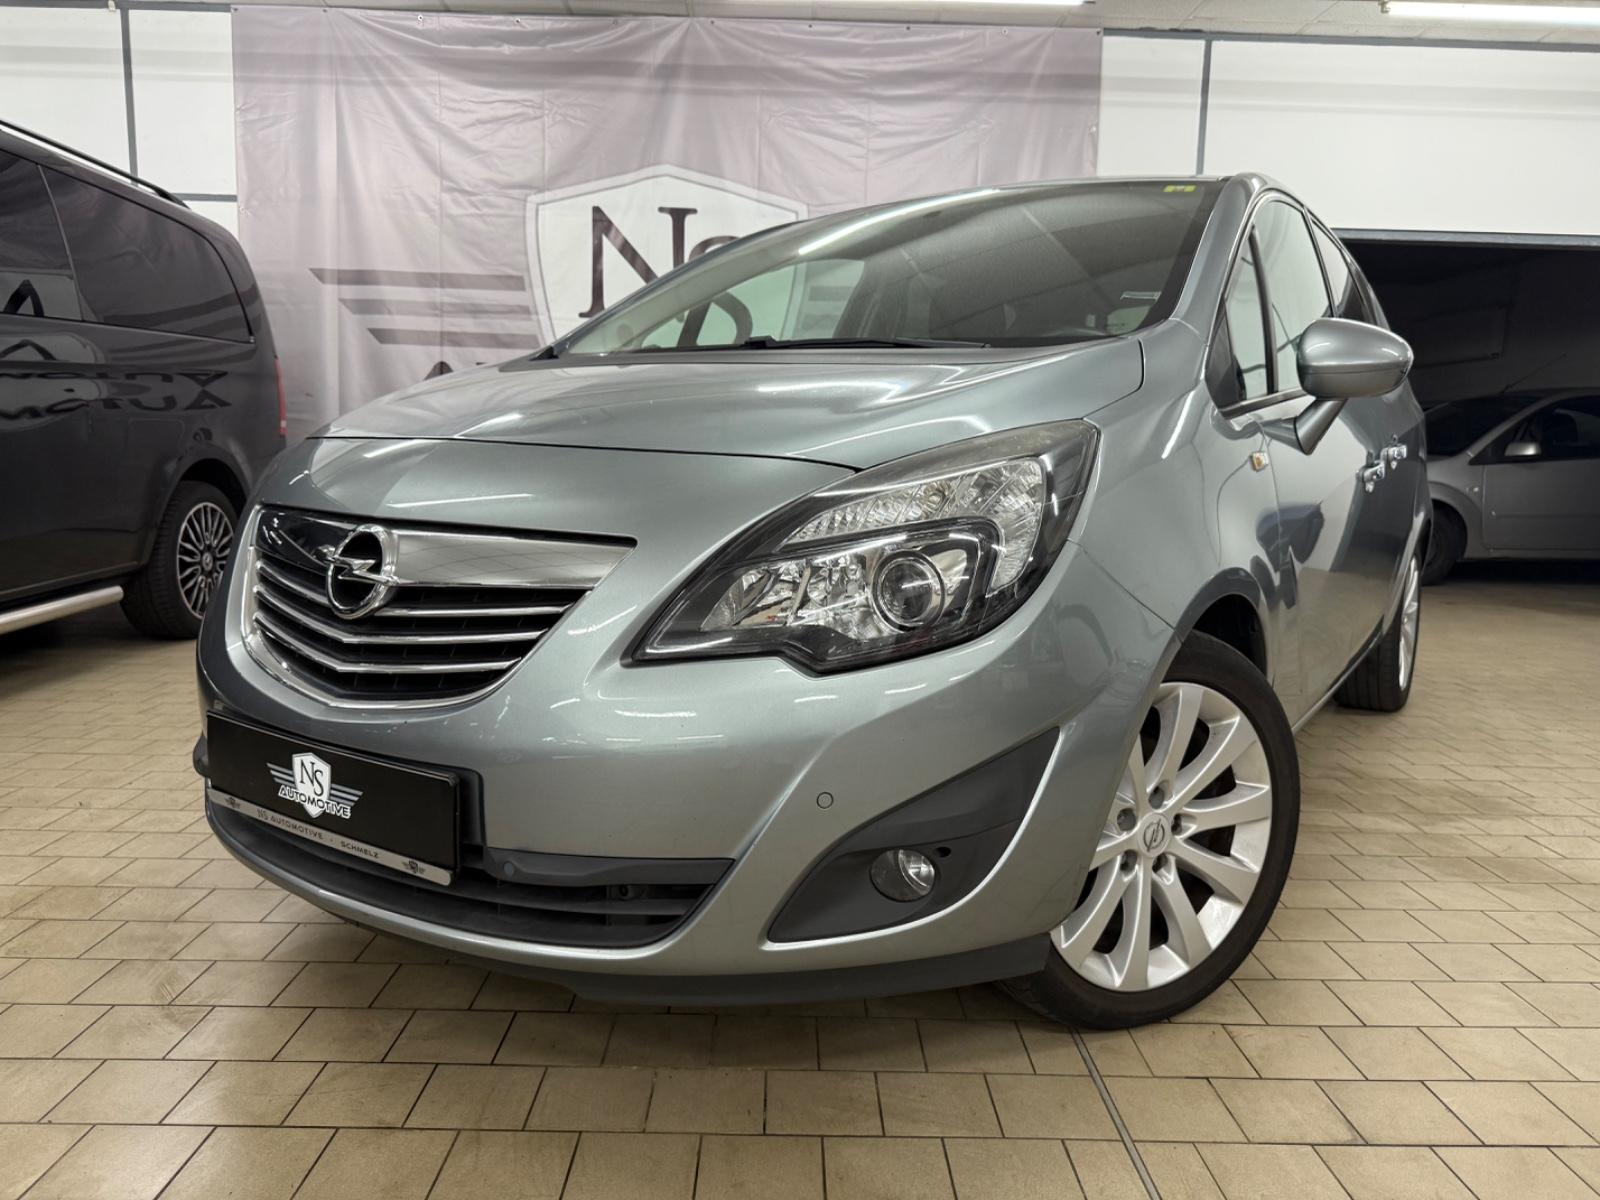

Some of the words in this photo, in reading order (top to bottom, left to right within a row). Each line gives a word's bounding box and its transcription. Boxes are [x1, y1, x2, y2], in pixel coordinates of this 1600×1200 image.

[300, 760, 325, 797] NS
[278, 785, 351, 818] AUTOMOTIVE
[257, 808, 269, 821] NS
[270, 814, 324, 840] AUTOMOTIVE
[340, 840, 380, 860] SCHMELZ
